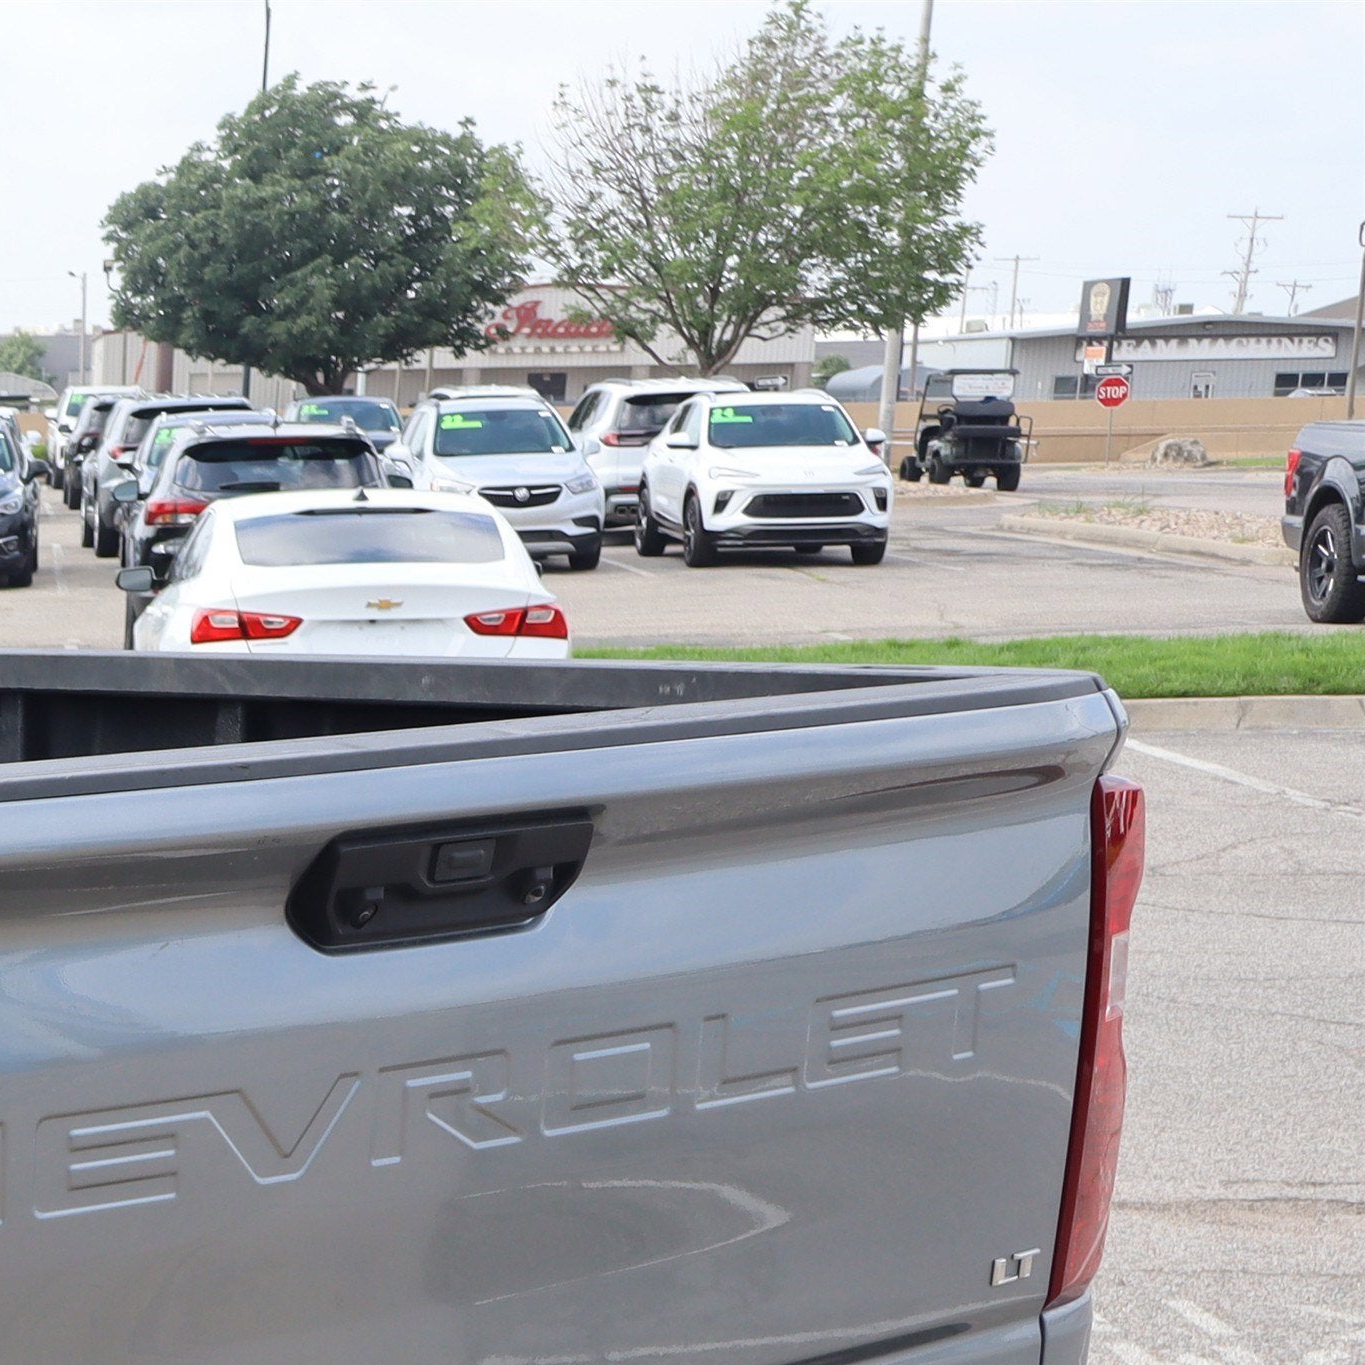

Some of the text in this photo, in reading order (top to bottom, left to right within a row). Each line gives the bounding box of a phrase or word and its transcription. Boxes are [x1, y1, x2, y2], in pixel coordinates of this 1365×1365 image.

[486, 300, 619, 341] India
[1189, 335, 1334, 354] MACHINES
[1098, 385, 1128, 399] STOP
[990, 1248, 1041, 1287] LT
